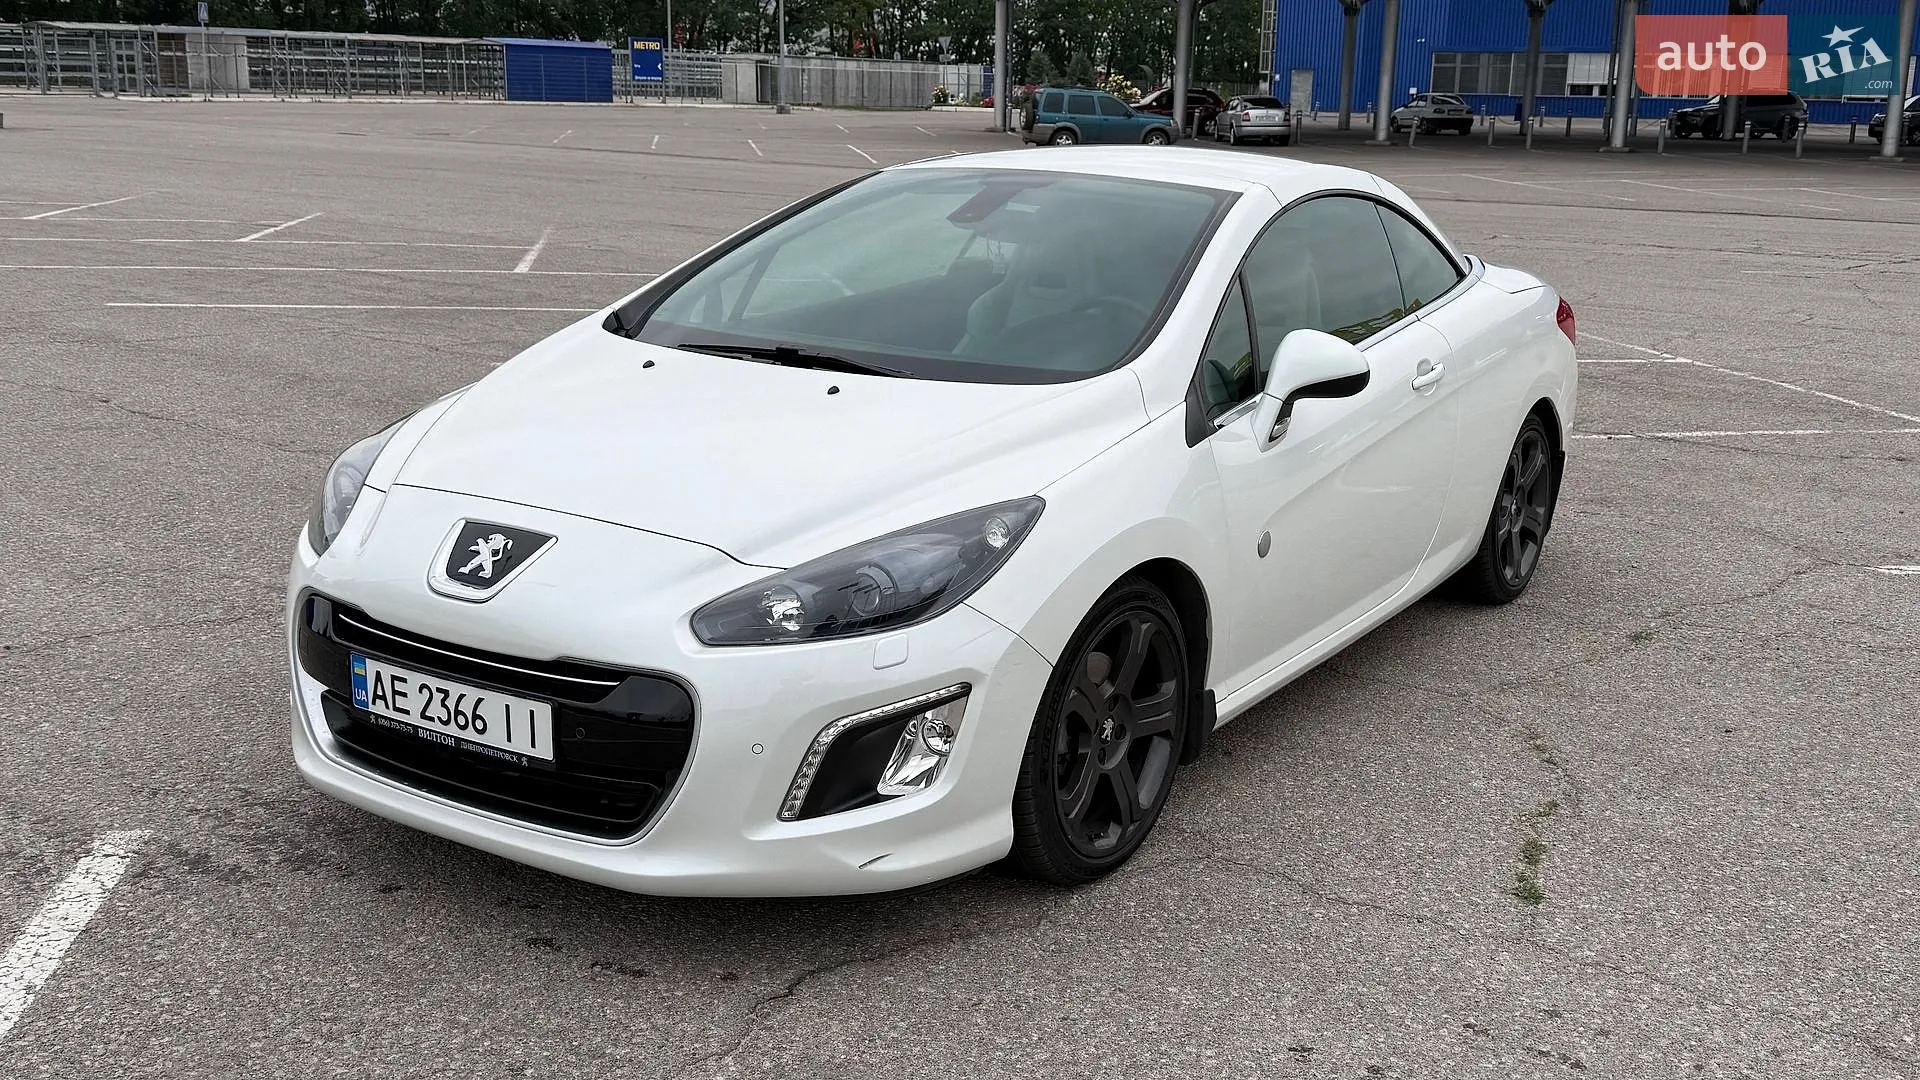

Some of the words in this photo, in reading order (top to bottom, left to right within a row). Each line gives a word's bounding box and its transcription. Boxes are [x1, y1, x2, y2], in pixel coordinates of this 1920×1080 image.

[633, 41, 660, 50] METRO
[355, 688, 368, 702] UA
[371, 670, 411, 716] AE
[418, 683, 488, 735] 2366
[418, 728, 455, 747] ВИЛТОН
